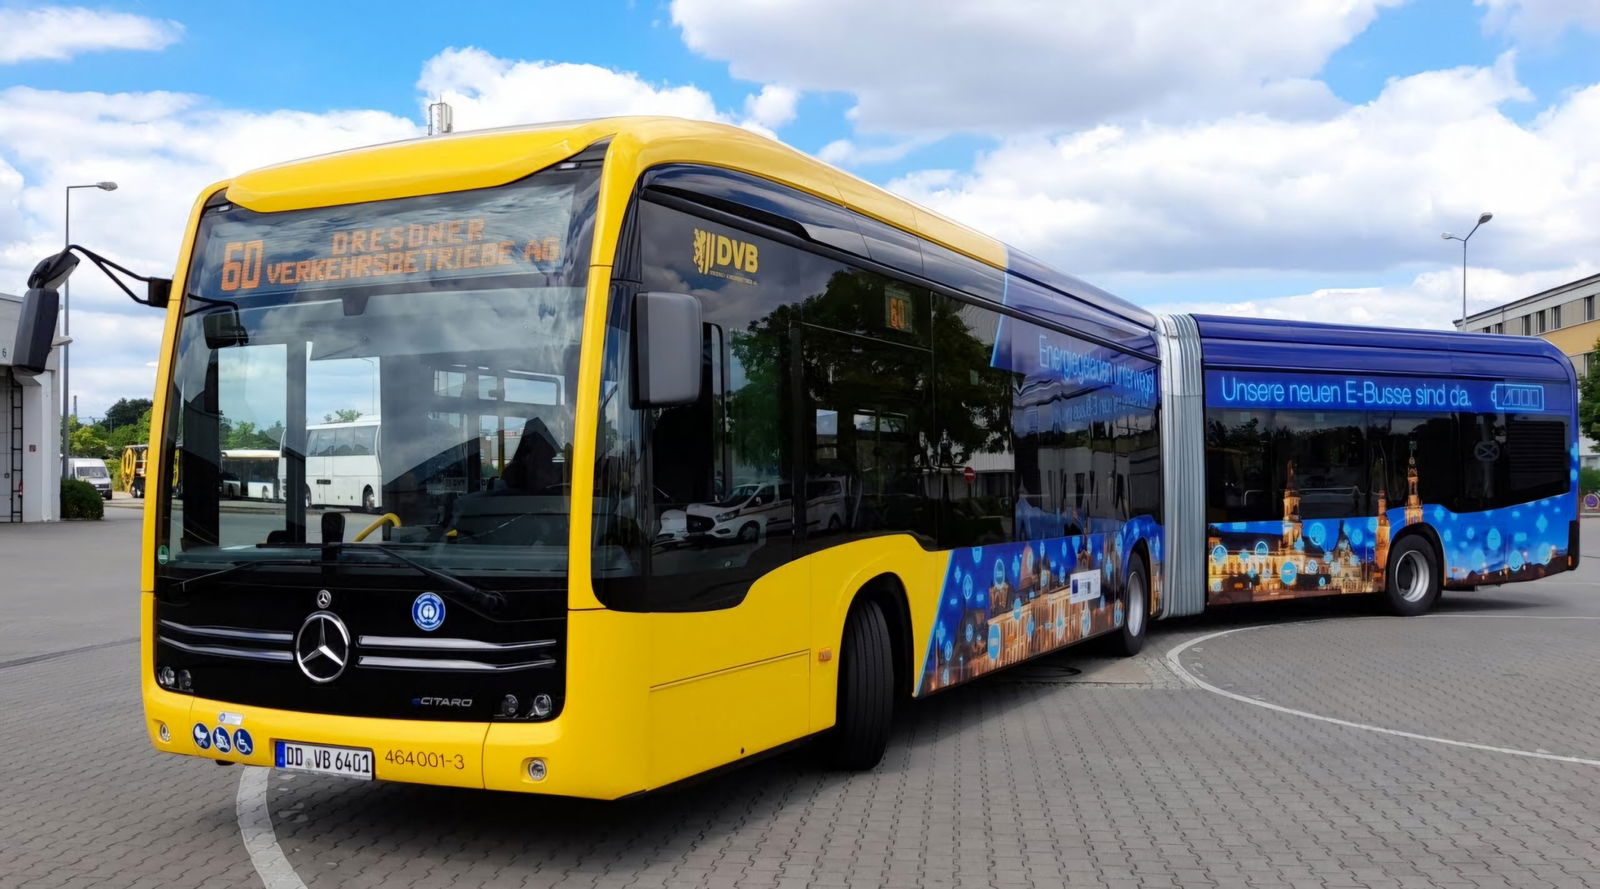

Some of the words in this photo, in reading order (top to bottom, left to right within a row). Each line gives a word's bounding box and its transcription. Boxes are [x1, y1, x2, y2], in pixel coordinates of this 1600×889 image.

[332, 219, 484, 254] DRESDNER
[221, 240, 264, 291] 60
[267, 240, 515, 284] VERKEHRSBETRIEBE
[524, 237, 561, 261] AG
[716, 236, 759, 274] DVB
[1039, 335, 1112, 384] Energiegeladen
[1221, 377, 1285, 402] Unsere
[1290, 383, 1340, 404] neuen
[1346, 382, 1412, 406] E-Busse
[1415, 384, 1446, 406] sind
[1450, 386, 1472, 407] da.
[286, 746, 303, 766] DD
[313, 749, 332, 769] VB
[335, 752, 371, 773] 6401
[385, 750, 465, 770] 464001-3
